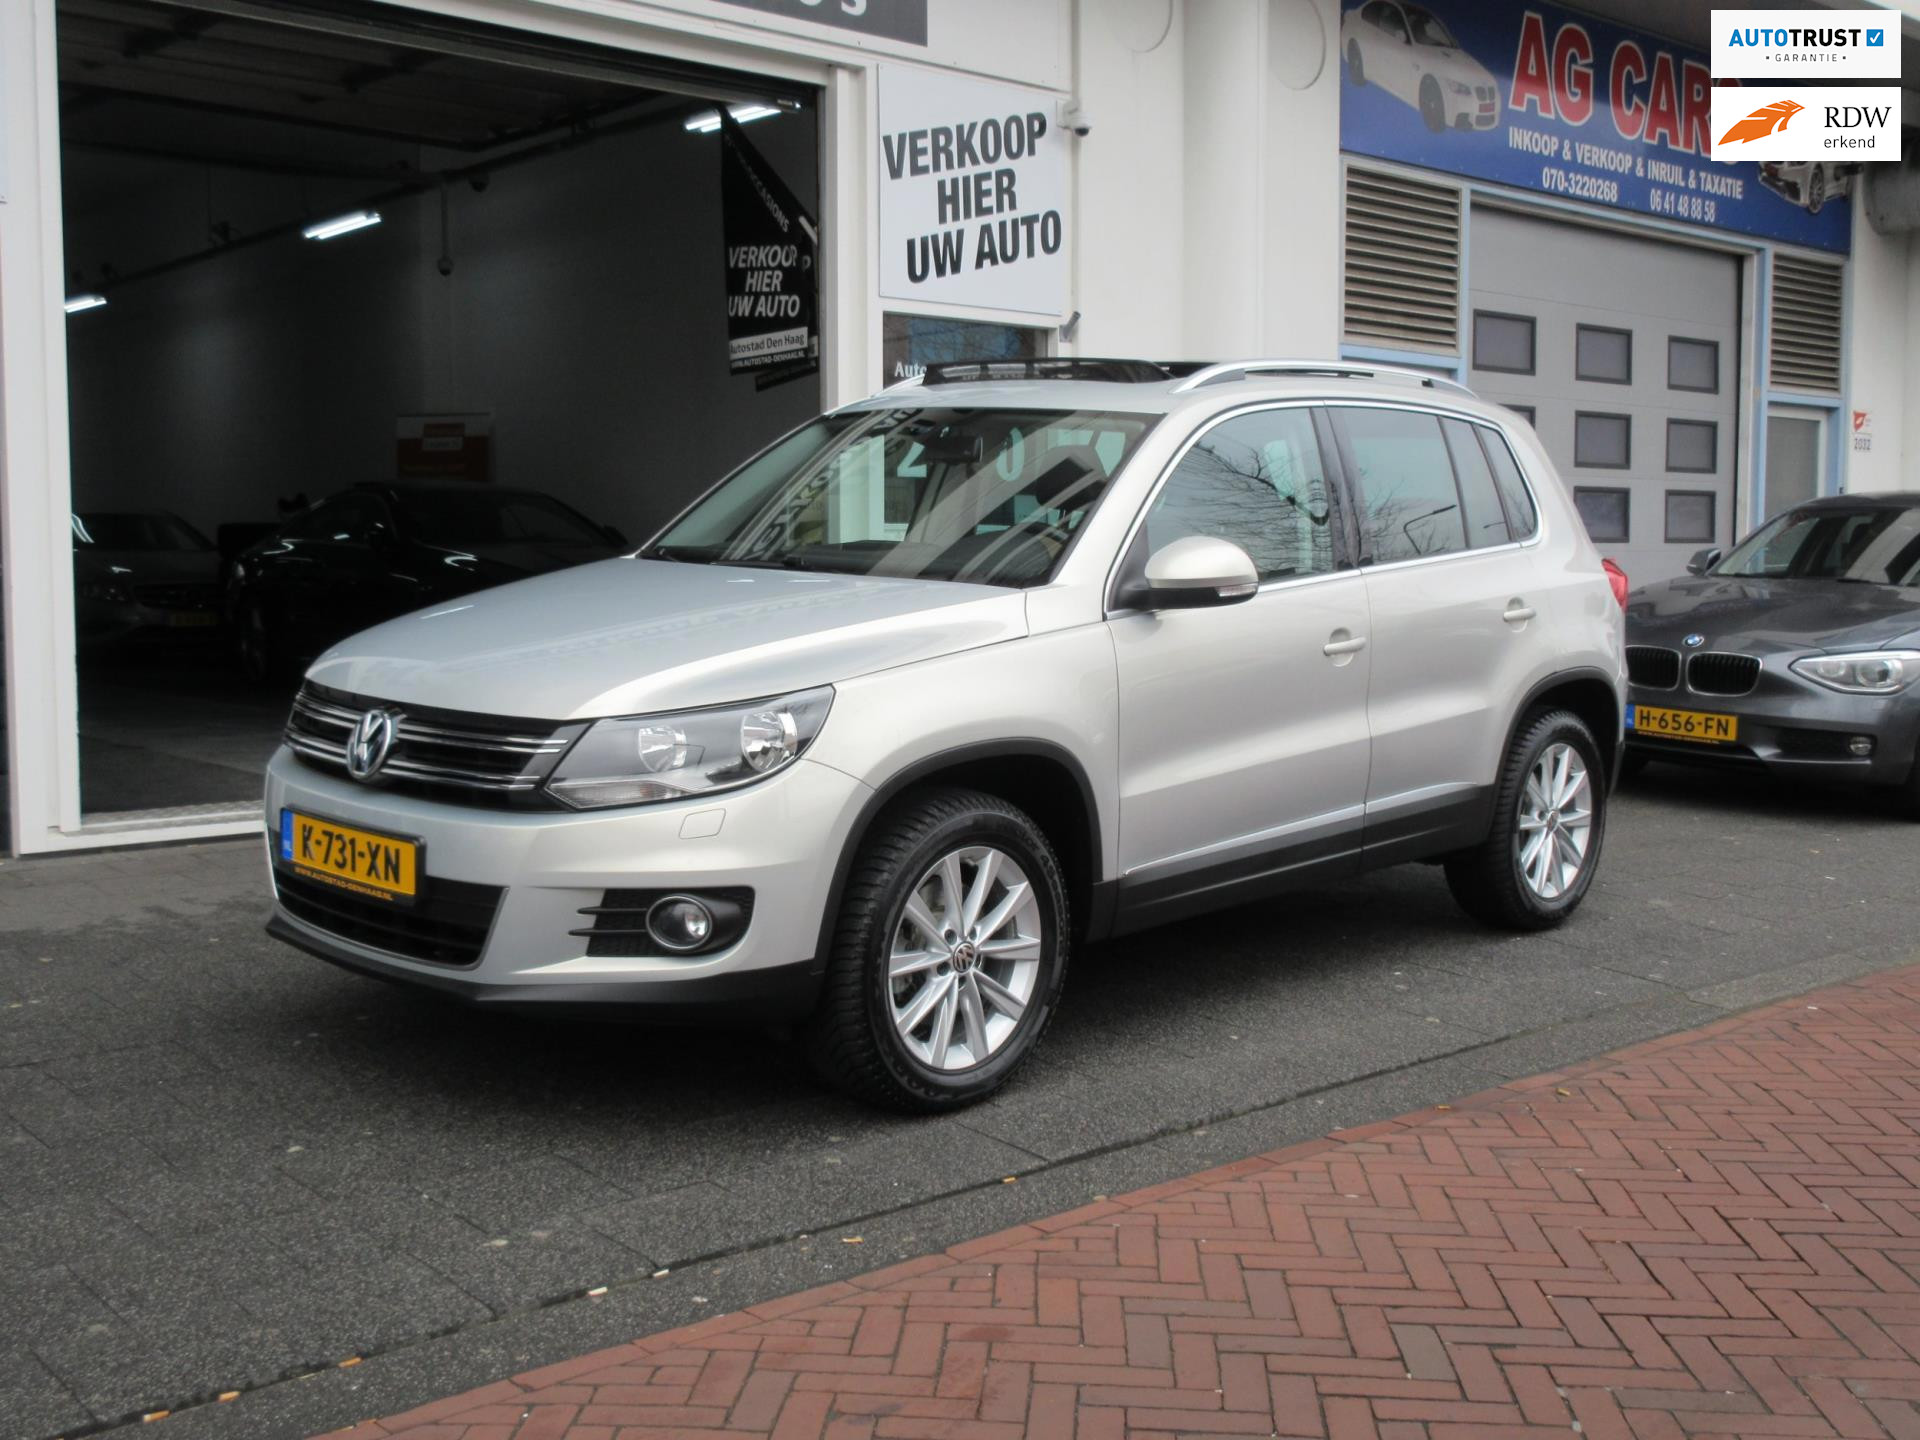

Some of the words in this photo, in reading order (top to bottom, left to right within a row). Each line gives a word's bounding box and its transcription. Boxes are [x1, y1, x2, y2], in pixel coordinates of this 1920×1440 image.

[1509, 11, 1593, 126] AG
[1609, 40, 1742, 165] CAR
[882, 112, 1047, 180] VERKOOP
[1509, 126, 1558, 157] INKOOP
[1562, 140, 1571, 160] &
[1576, 142, 1632, 174] VERKOOP
[1635, 157, 1645, 177] &
[1648, 160, 1685, 187] INRUIL
[1688, 169, 1697, 189] &
[1700, 172, 1743, 199] TAXATIE
[937, 168, 1017, 225] HIER
[1542, 167, 1618, 203] 070-3220268
[1650, 189, 1661, 211] 06
[1664, 193, 1675, 214] 41
[1677, 197, 1689, 217] 48
[1691, 200, 1702, 220] 88
[1704, 202, 1716, 222] 58
[907, 228, 964, 284] UW
[975, 209, 1062, 270] AUTO
[745, 270, 783, 293] HIER
[728, 295, 755, 317] UW
[755, 294, 801, 317] AUTO
[766, 337, 783, 349] Den
[784, 334, 805, 346] Haag
[1639, 709, 1729, 736] H-656-FN
[302, 823, 400, 885] K-731-XN
